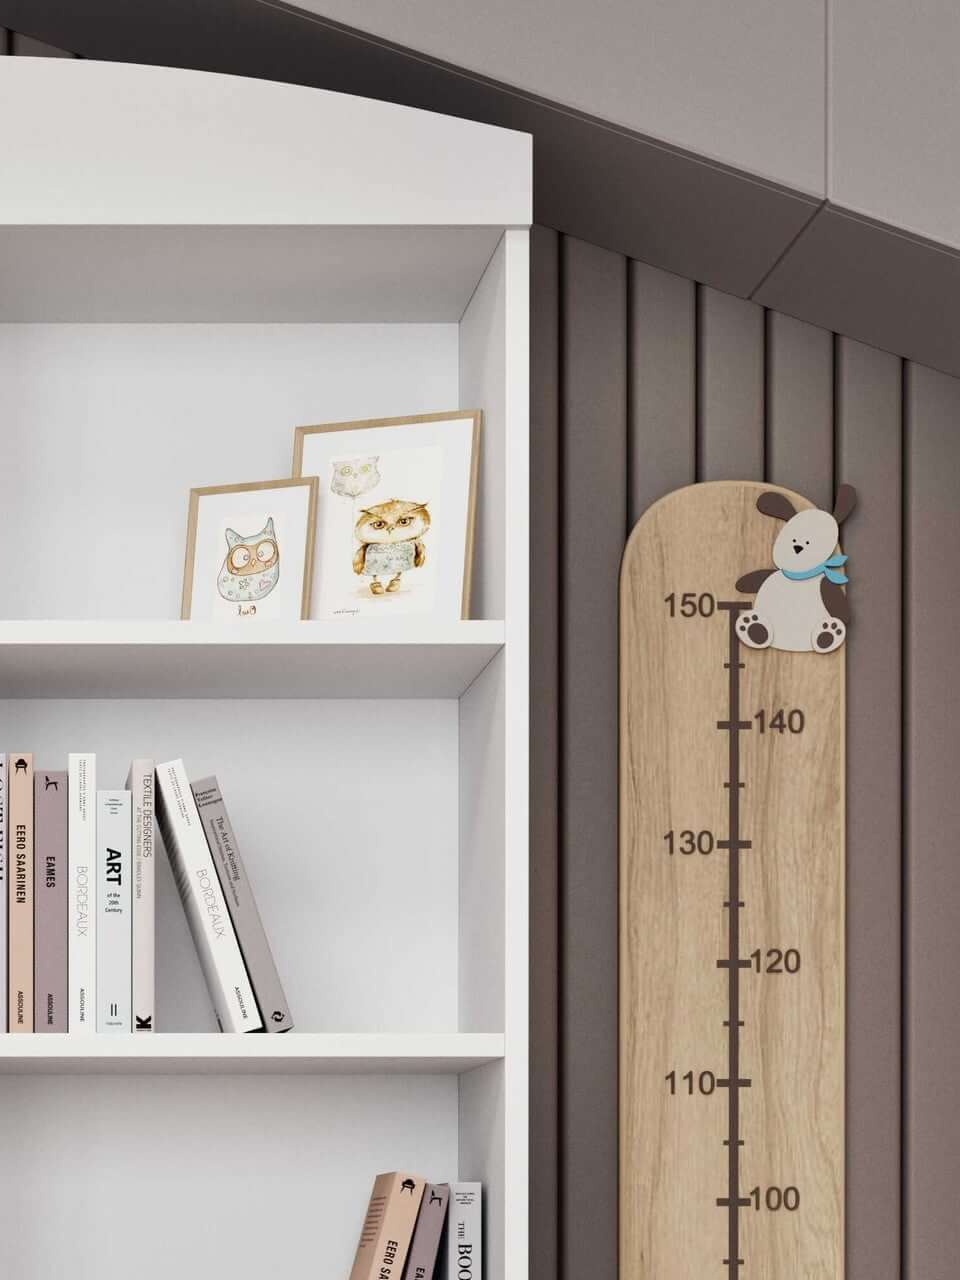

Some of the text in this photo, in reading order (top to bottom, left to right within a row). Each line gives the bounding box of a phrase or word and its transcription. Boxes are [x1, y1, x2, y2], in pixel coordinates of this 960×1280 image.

[664, 594, 715, 617] 150
[753, 710, 805, 734] 140
[143, 774, 153, 858] TEXTILE DESIGNERS
[664, 833, 715, 856] 130
[16, 824, 26, 904] EERO SAARINEN
[46, 856, 56, 888] EAMES
[106, 847, 122, 886] ART
[77, 866, 88, 937] BORDEAUX
[196, 868, 227, 939] BORDEAUX
[751, 951, 802, 974] 120
[665, 1072, 715, 1096] 110
[749, 1187, 800, 1210] 100
[383, 1240, 398, 1265] EERO
